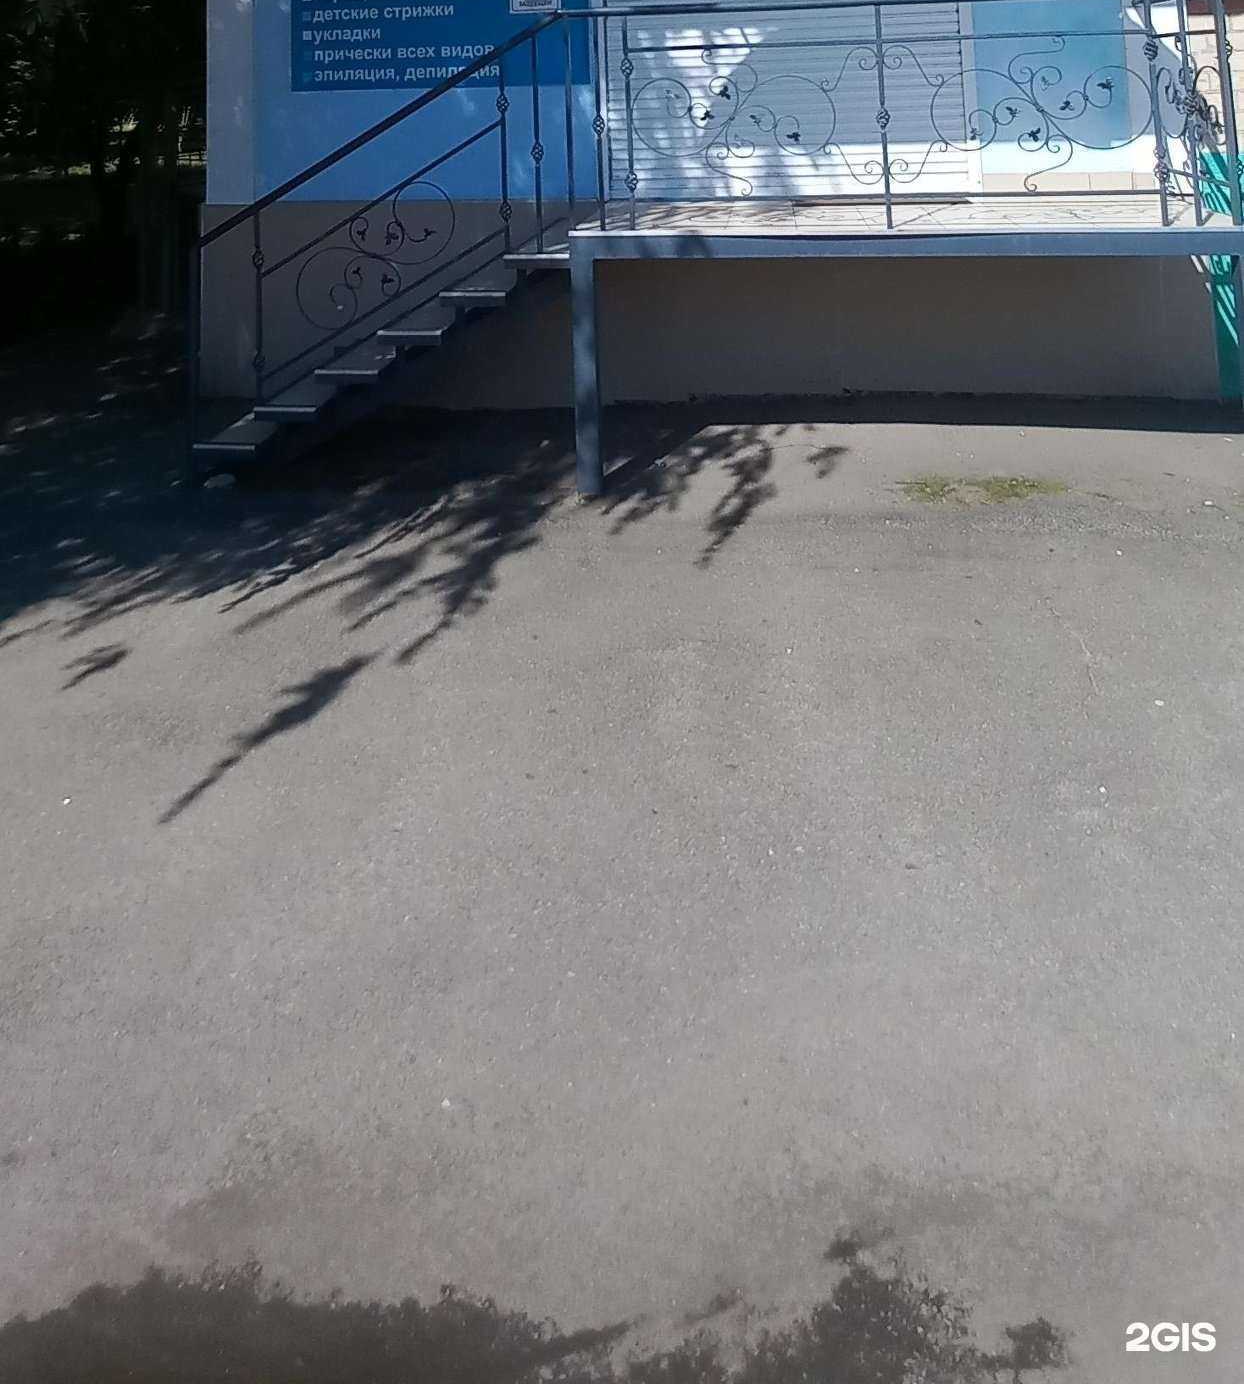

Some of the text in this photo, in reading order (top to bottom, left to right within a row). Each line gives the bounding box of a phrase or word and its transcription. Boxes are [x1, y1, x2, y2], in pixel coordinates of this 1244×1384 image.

[313, 3, 454, 24] детские стрижки
[313, 27, 381, 45] укладки
[314, 43, 496, 65] прически всех видов
[314, 66, 400, 83] эпиляция,
